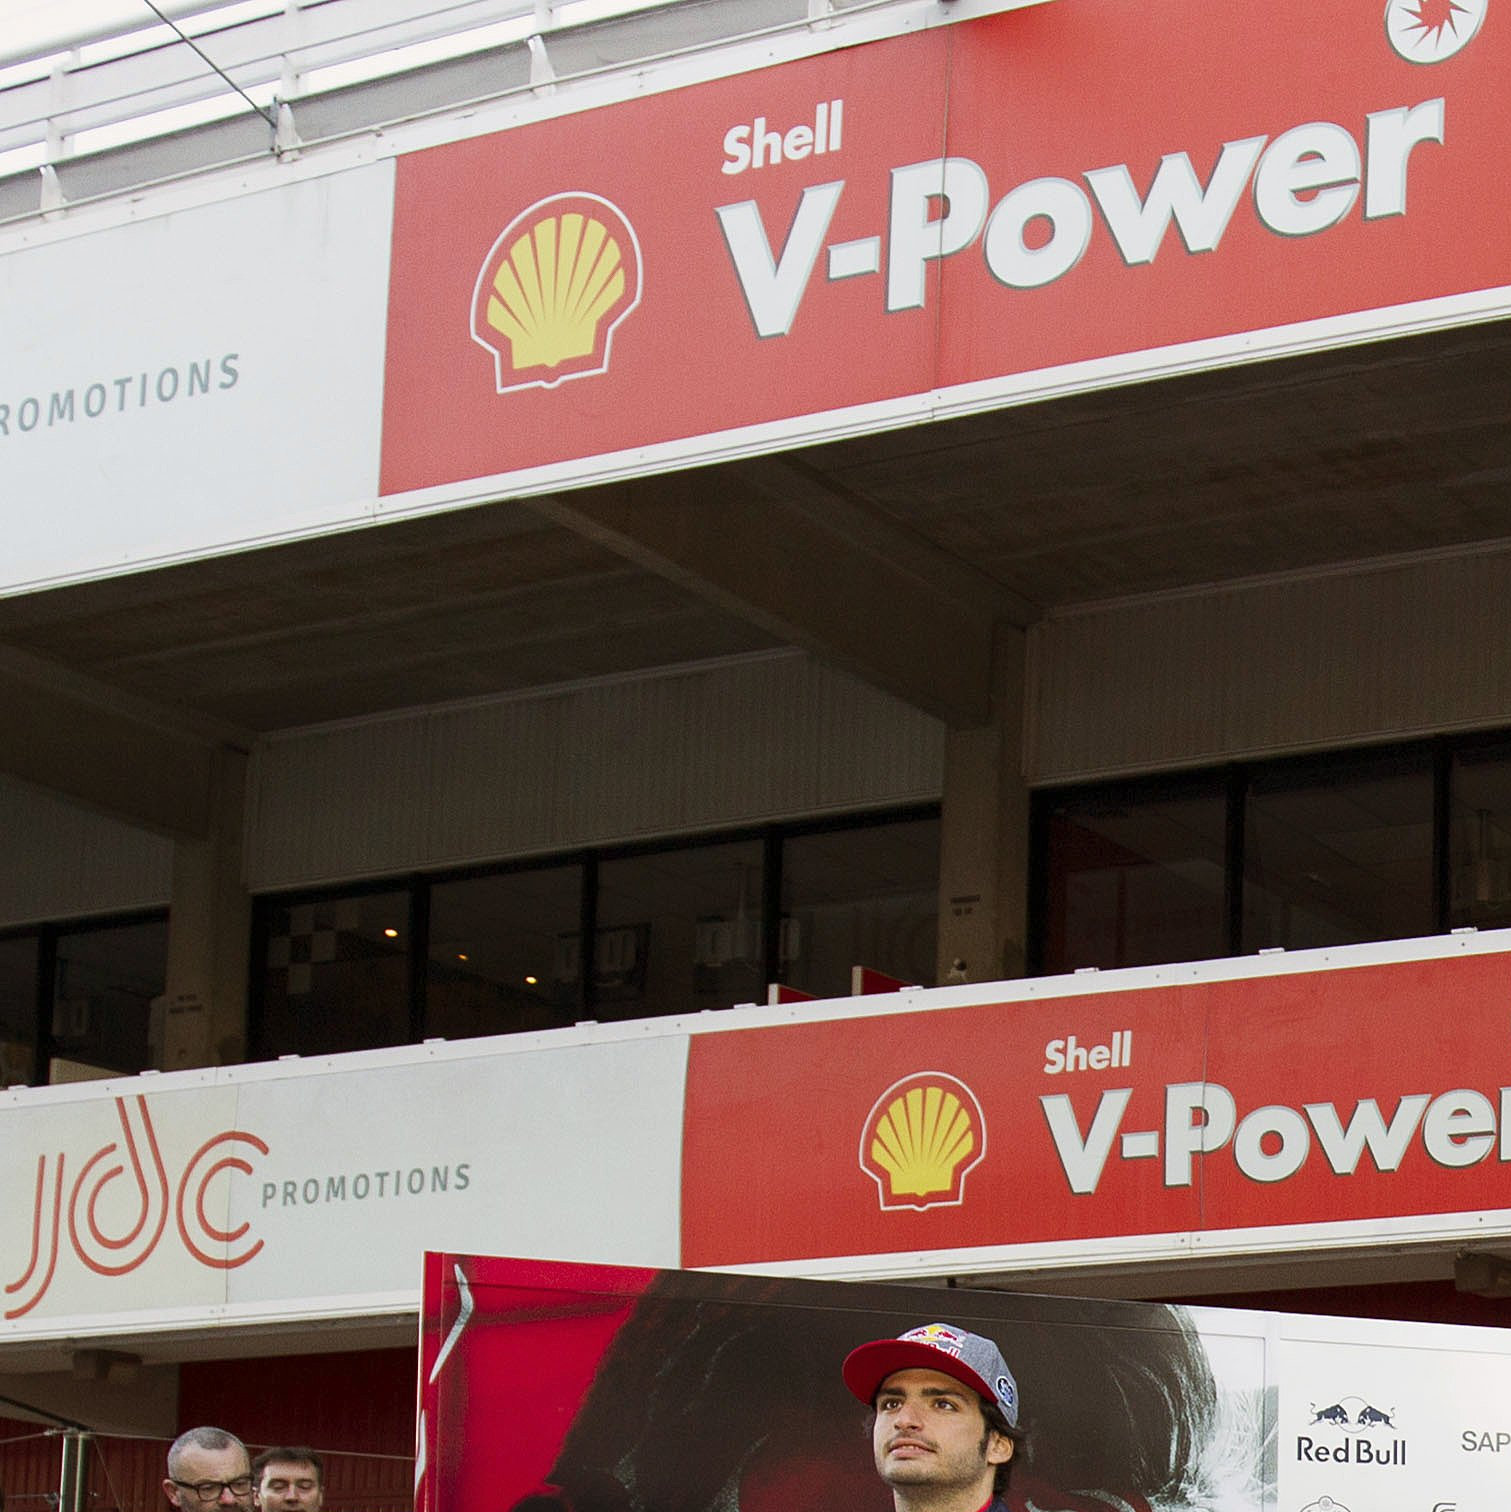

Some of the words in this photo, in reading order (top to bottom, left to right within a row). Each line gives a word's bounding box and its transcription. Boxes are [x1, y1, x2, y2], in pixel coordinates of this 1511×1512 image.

[722, 99, 844, 175] Shell
[714, 97, 1446, 340] V-Power
[0, 352, 240, 436] ROMOTIONS
[1043, 1031, 1132, 1074] Shell
[262, 1162, 472, 1209] PROMOTIONS
[1297, 1436, 1349, 1463] Red
[1356, 1439, 1406, 1465] Bull
